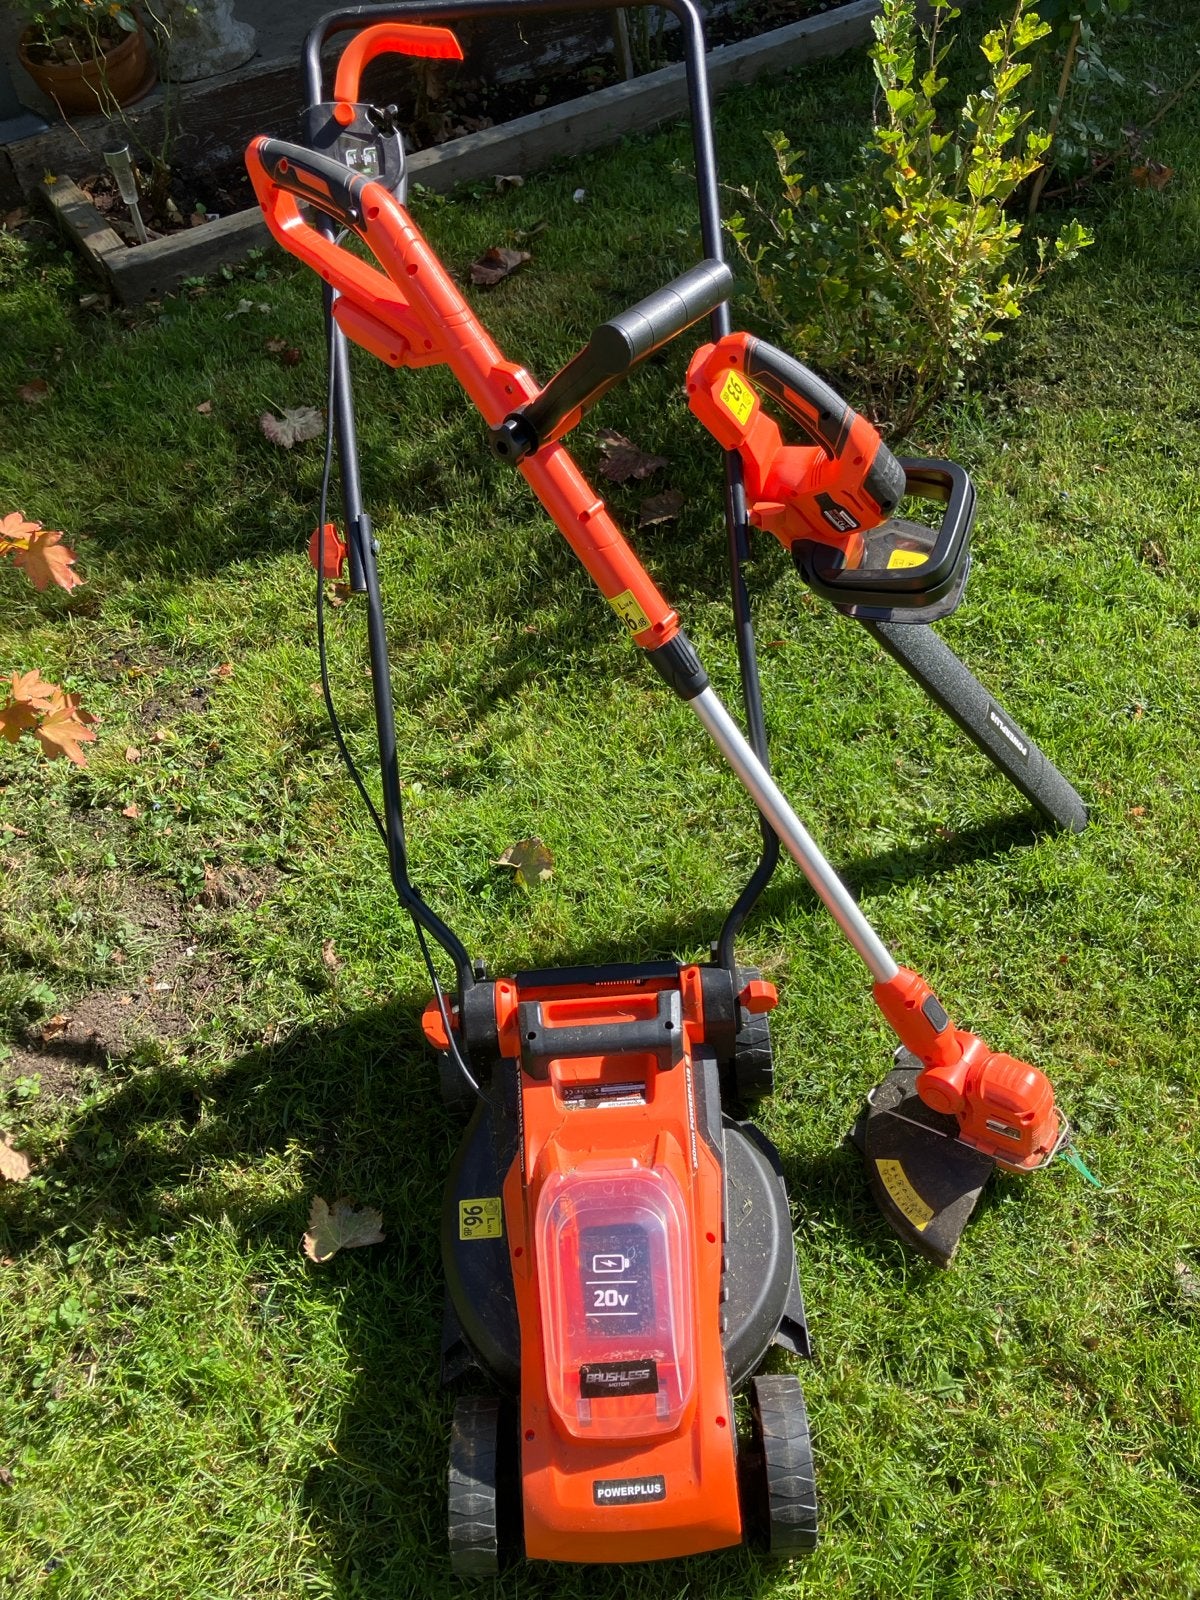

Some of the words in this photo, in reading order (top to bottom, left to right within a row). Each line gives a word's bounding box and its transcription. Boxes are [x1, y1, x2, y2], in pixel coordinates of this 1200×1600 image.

[727, 377, 742, 401] 93
[990, 711, 1027, 756] POWERPLUS
[686, 1067, 695, 1131] POWERPLUS
[463, 1205, 483, 1226] 96
[463, 1227, 472, 1236] dB
[585, 1369, 650, 1383] BRUSHLESS
[597, 1484, 663, 1499] POWERPLUS
